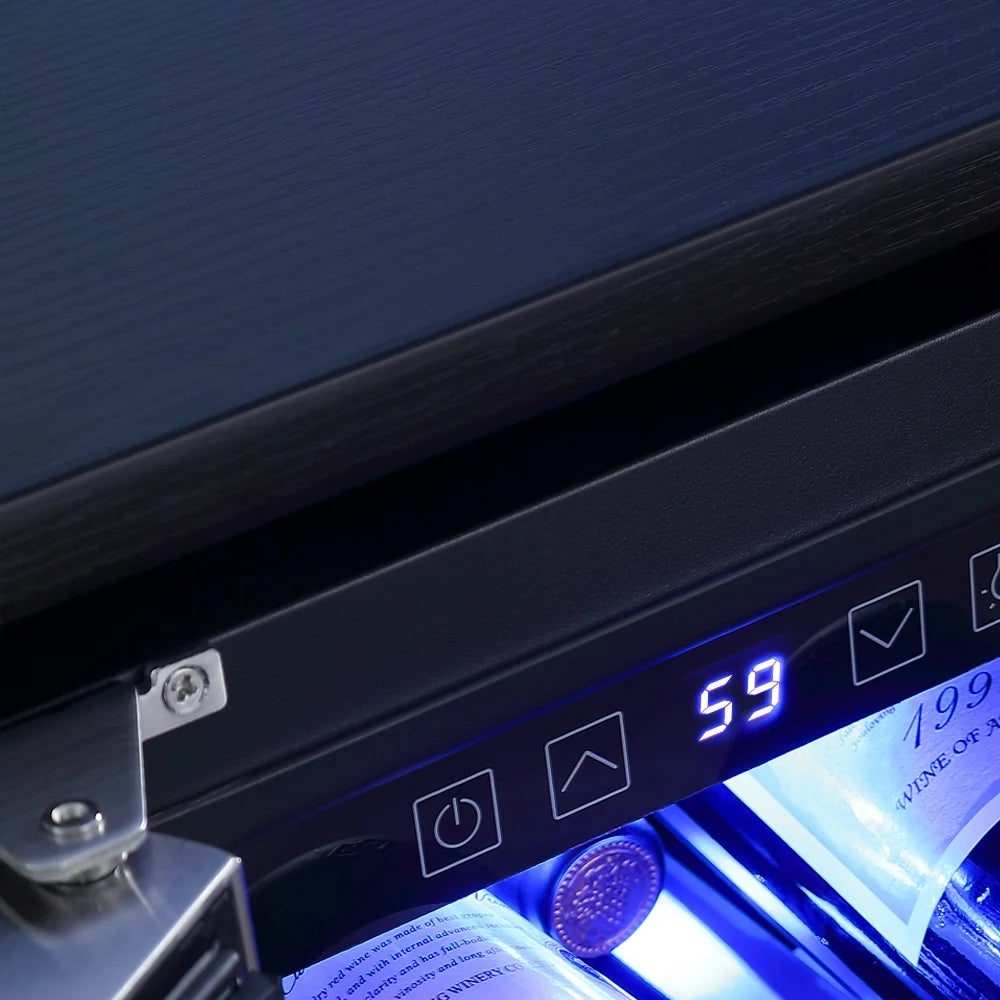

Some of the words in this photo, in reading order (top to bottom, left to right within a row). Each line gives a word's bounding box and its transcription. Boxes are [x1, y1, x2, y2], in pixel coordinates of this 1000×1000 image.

[698, 657, 782, 742] 59
[895, 752, 952, 812] WINE
[952, 728, 981, 755] OF
[328, 969, 346, 989] red
[345, 951, 371, 972] wine
[370, 938, 393, 953] was
[392, 924, 423, 941] made
[424, 916, 437, 928] of
[346, 974, 367, 996] and
[366, 958, 391, 978] with
[390, 934, 435, 962] internal
[435, 923, 484, 940] advanced
[394, 970, 437, 1000] vinosity
[437, 957, 459, 974] and
[460, 949, 486, 963] long
[399, 959, 421, 977] and
[420, 950, 440, 963] has
[447, 966, 505, 995] WINERY
